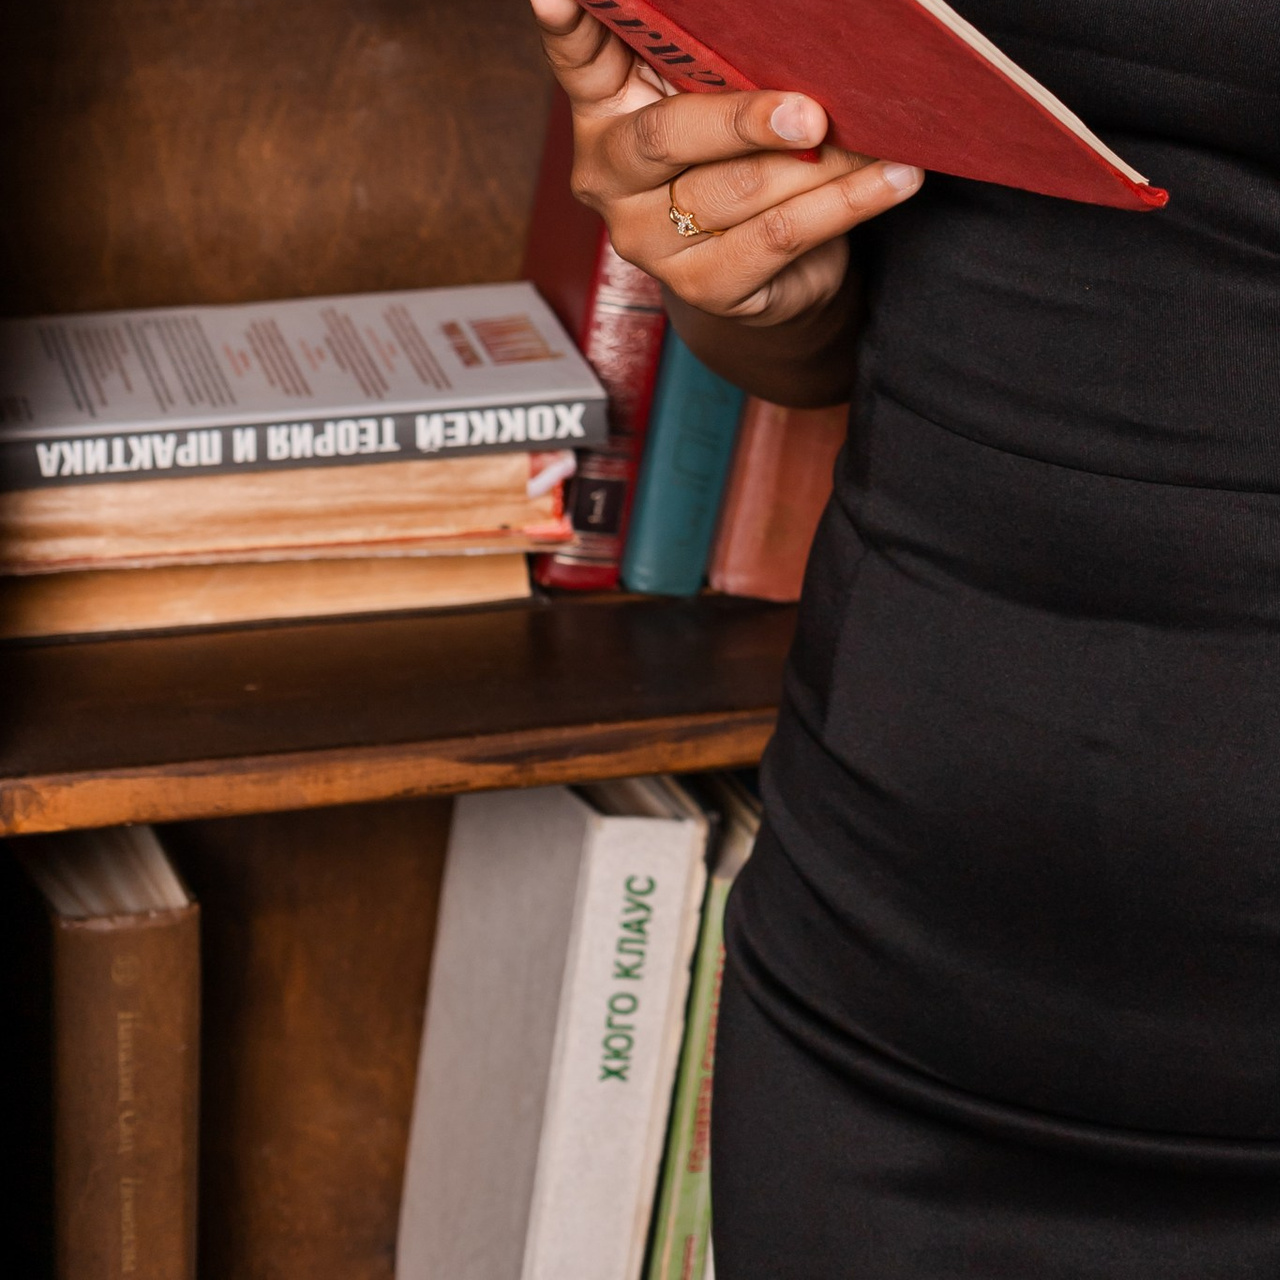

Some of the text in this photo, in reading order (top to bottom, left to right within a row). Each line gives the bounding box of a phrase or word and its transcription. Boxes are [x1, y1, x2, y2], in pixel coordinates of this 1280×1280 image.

[36, 403, 586, 478] ХОККЕЙ ТЕОРИЯ И ПРАКТИКА
[598, 874, 657, 1083] ХЮГО КЛАУС
